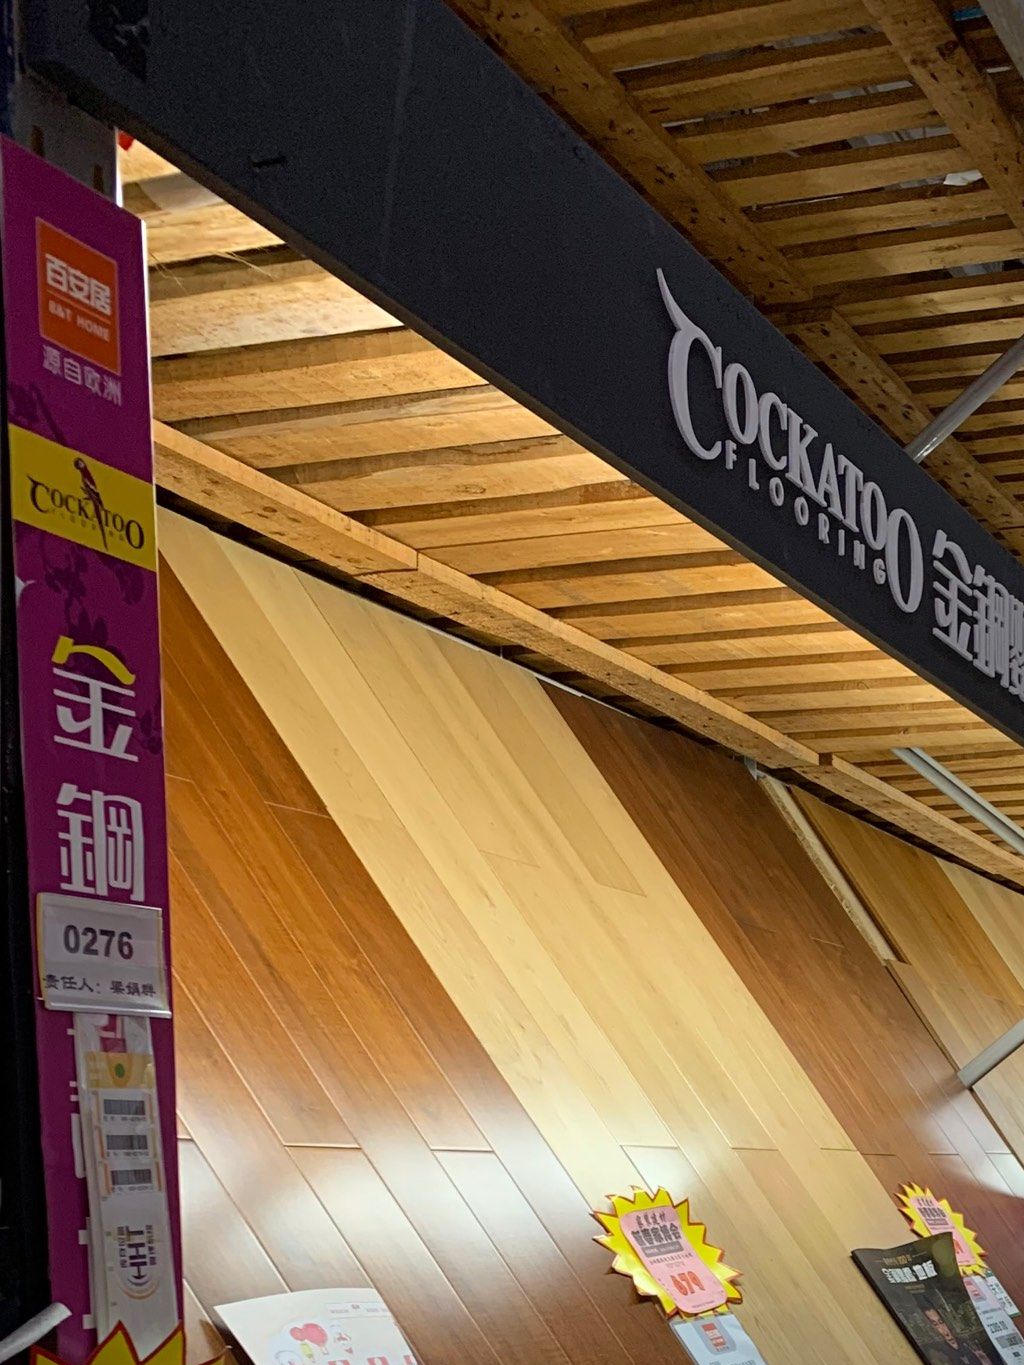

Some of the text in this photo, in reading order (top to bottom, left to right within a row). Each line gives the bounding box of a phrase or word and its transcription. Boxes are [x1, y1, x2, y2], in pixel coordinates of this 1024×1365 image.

[45, 253, 112, 316] 百安居
[657, 268, 925, 613] COCKATOO
[724, 439, 887, 585] FLOORING
[63, 924, 134, 960] 0276
